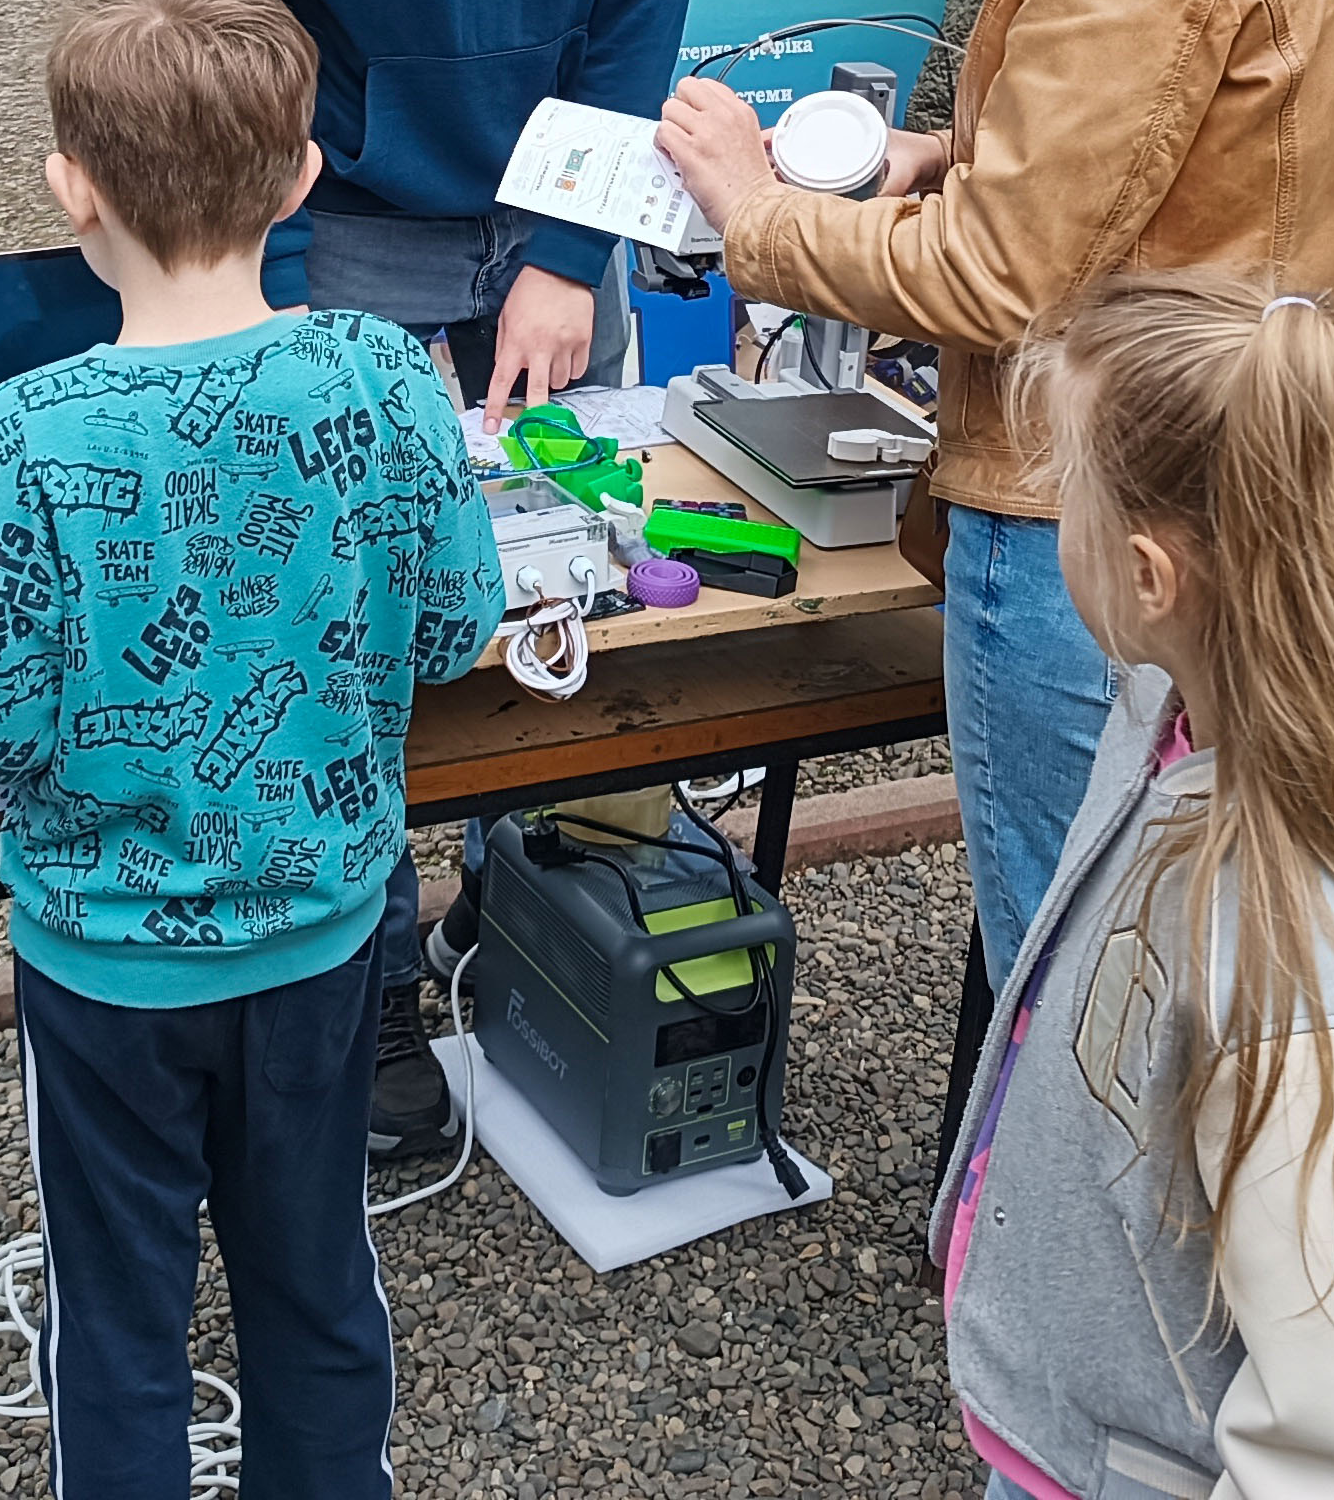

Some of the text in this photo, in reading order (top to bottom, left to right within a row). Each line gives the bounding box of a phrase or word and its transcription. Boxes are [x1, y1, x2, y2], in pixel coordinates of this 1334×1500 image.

[233, 410, 290, 437] SKATE
[234, 434, 281, 458] TEAM
[286, 405, 377, 485] LET'S
[164, 467, 217, 499] MOOD
[160, 493, 220, 535] SKATE
[236, 492, 293, 550] MOOD
[259, 496, 316, 566] SKATE
[95, 539, 156, 562] SKATE
[100, 563, 150, 583] TEAM
[121, 583, 203, 687] LET'S
[253, 758, 305, 780] SKATE
[255, 782, 296, 803] TEAM
[190, 811, 239, 840] MOOD
[118, 837, 174, 879] SKATE
[115, 861, 160, 897] TEAM
